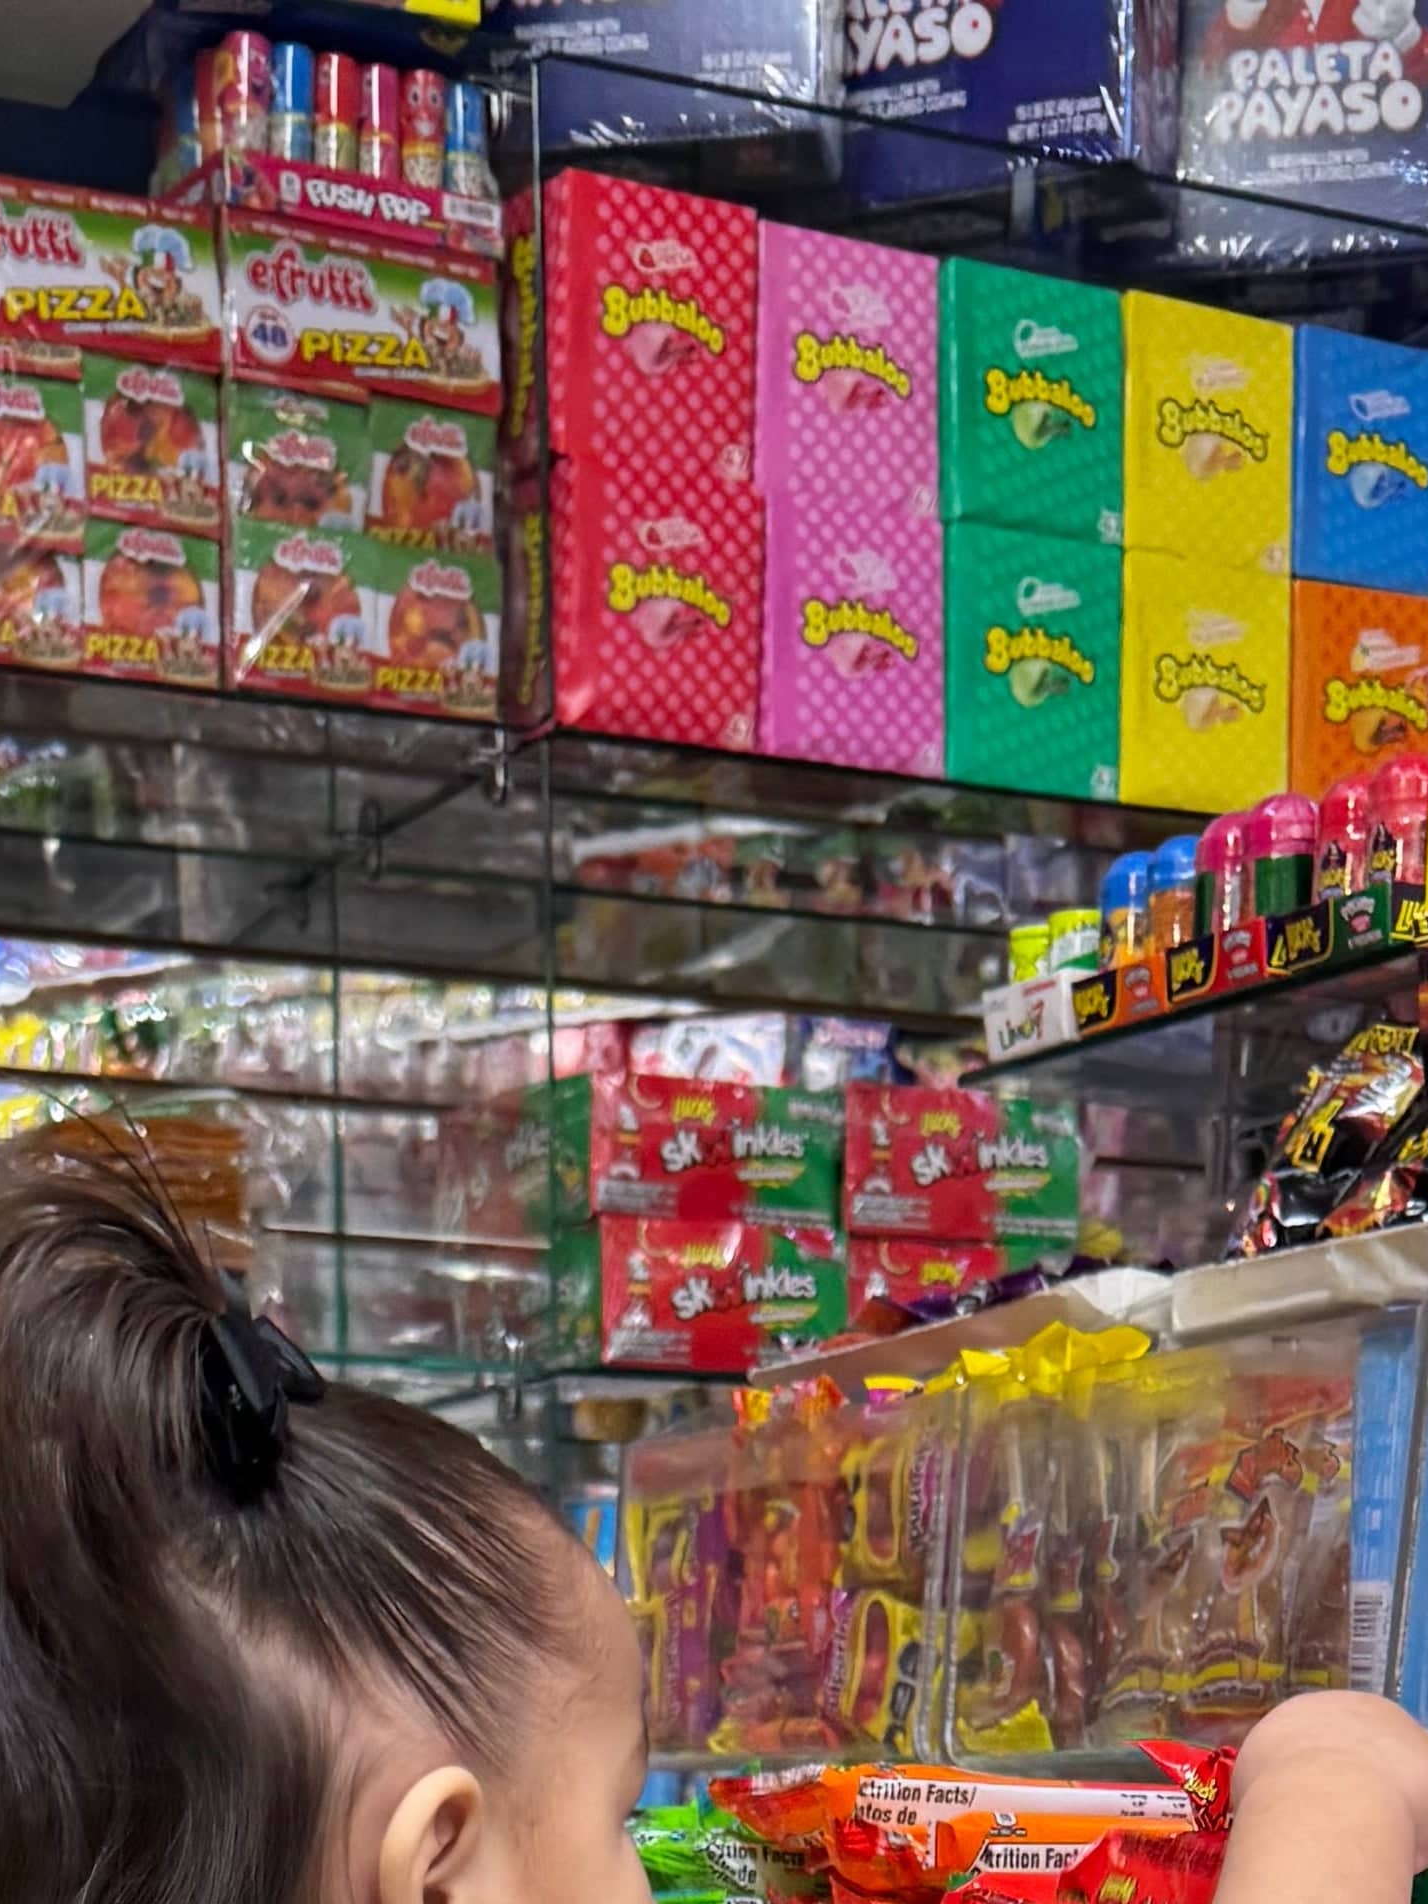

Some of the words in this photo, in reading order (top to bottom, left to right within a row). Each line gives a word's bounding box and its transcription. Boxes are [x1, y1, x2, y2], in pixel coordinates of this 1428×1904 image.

[1228, 42, 1405, 90] PALETA
[1215, 79, 1427, 142] PAYASO
[304, 178, 371, 217] PUSH
[378, 189, 430, 226] POP
[3, 286, 148, 323] PIZZA
[601, 281, 727, 356] Bubbaloo
[300, 330, 430, 367] PIZZA
[792, 330, 914, 399] Bubbaloo
[983, 367, 1098, 430] Bubbaloo
[1157, 397, 1269, 463] Bubbaloo
[89, 472, 163, 502] PIZZA
[608, 561, 732, 629] Bubbaloo
[83, 633, 160, 663] PIZZA
[802, 598, 919, 660] Bubbaloo
[983, 625, 1096, 685] Bubbaloo
[375, 667, 443, 694] PIZZA
[1153, 653, 1266, 714] Bubbaloo
[895, 1806, 918, 1827] de
[925, 1782, 976, 1807] Facts/
